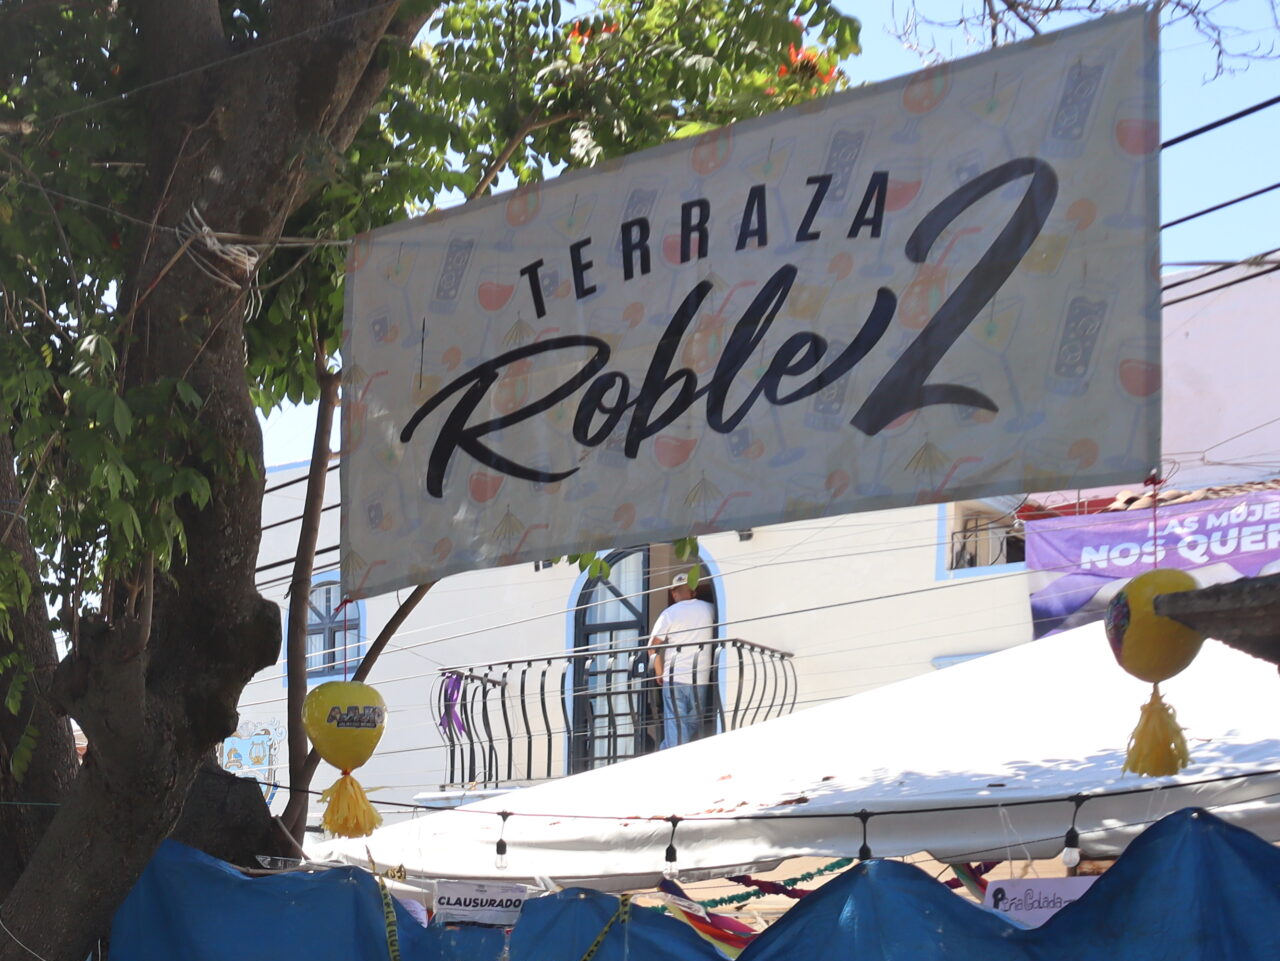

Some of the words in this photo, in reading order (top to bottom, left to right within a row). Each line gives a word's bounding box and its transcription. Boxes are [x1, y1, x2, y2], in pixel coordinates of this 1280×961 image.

[520, 170, 891, 318] TERRAZA
[400, 263, 898, 499] Roble
[850, 157, 1059, 437] 2
[1147, 515, 1200, 538] LAS
[1080, 538, 1167, 570] NOS
[437, 896, 522, 909] CLAUSURADO
